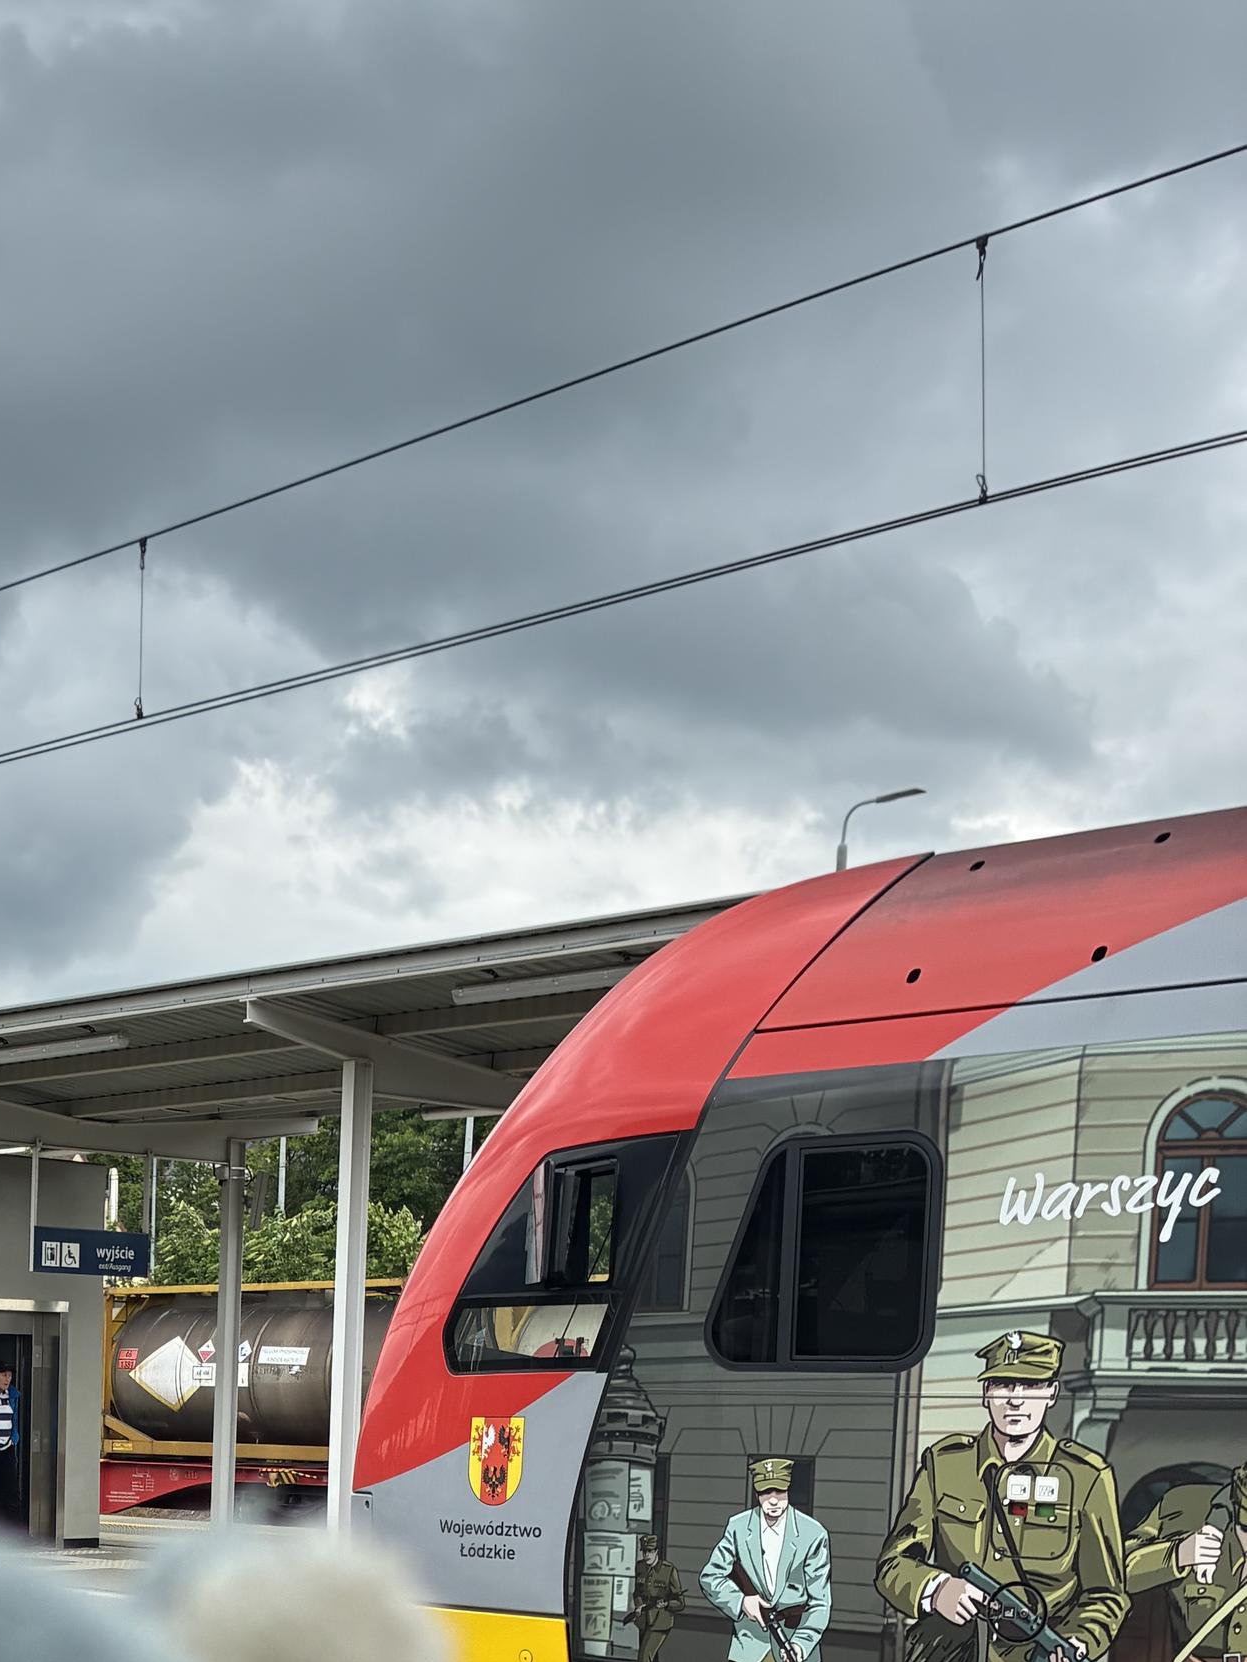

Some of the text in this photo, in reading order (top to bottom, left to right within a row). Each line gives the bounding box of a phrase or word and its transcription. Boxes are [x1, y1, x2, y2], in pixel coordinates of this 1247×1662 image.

[999, 1166, 1221, 1243] Warszyc
[96, 1245, 135, 1262] wyjście
[439, 1518, 542, 1540] Województwo
[459, 1542, 516, 1561] Łódzkie
